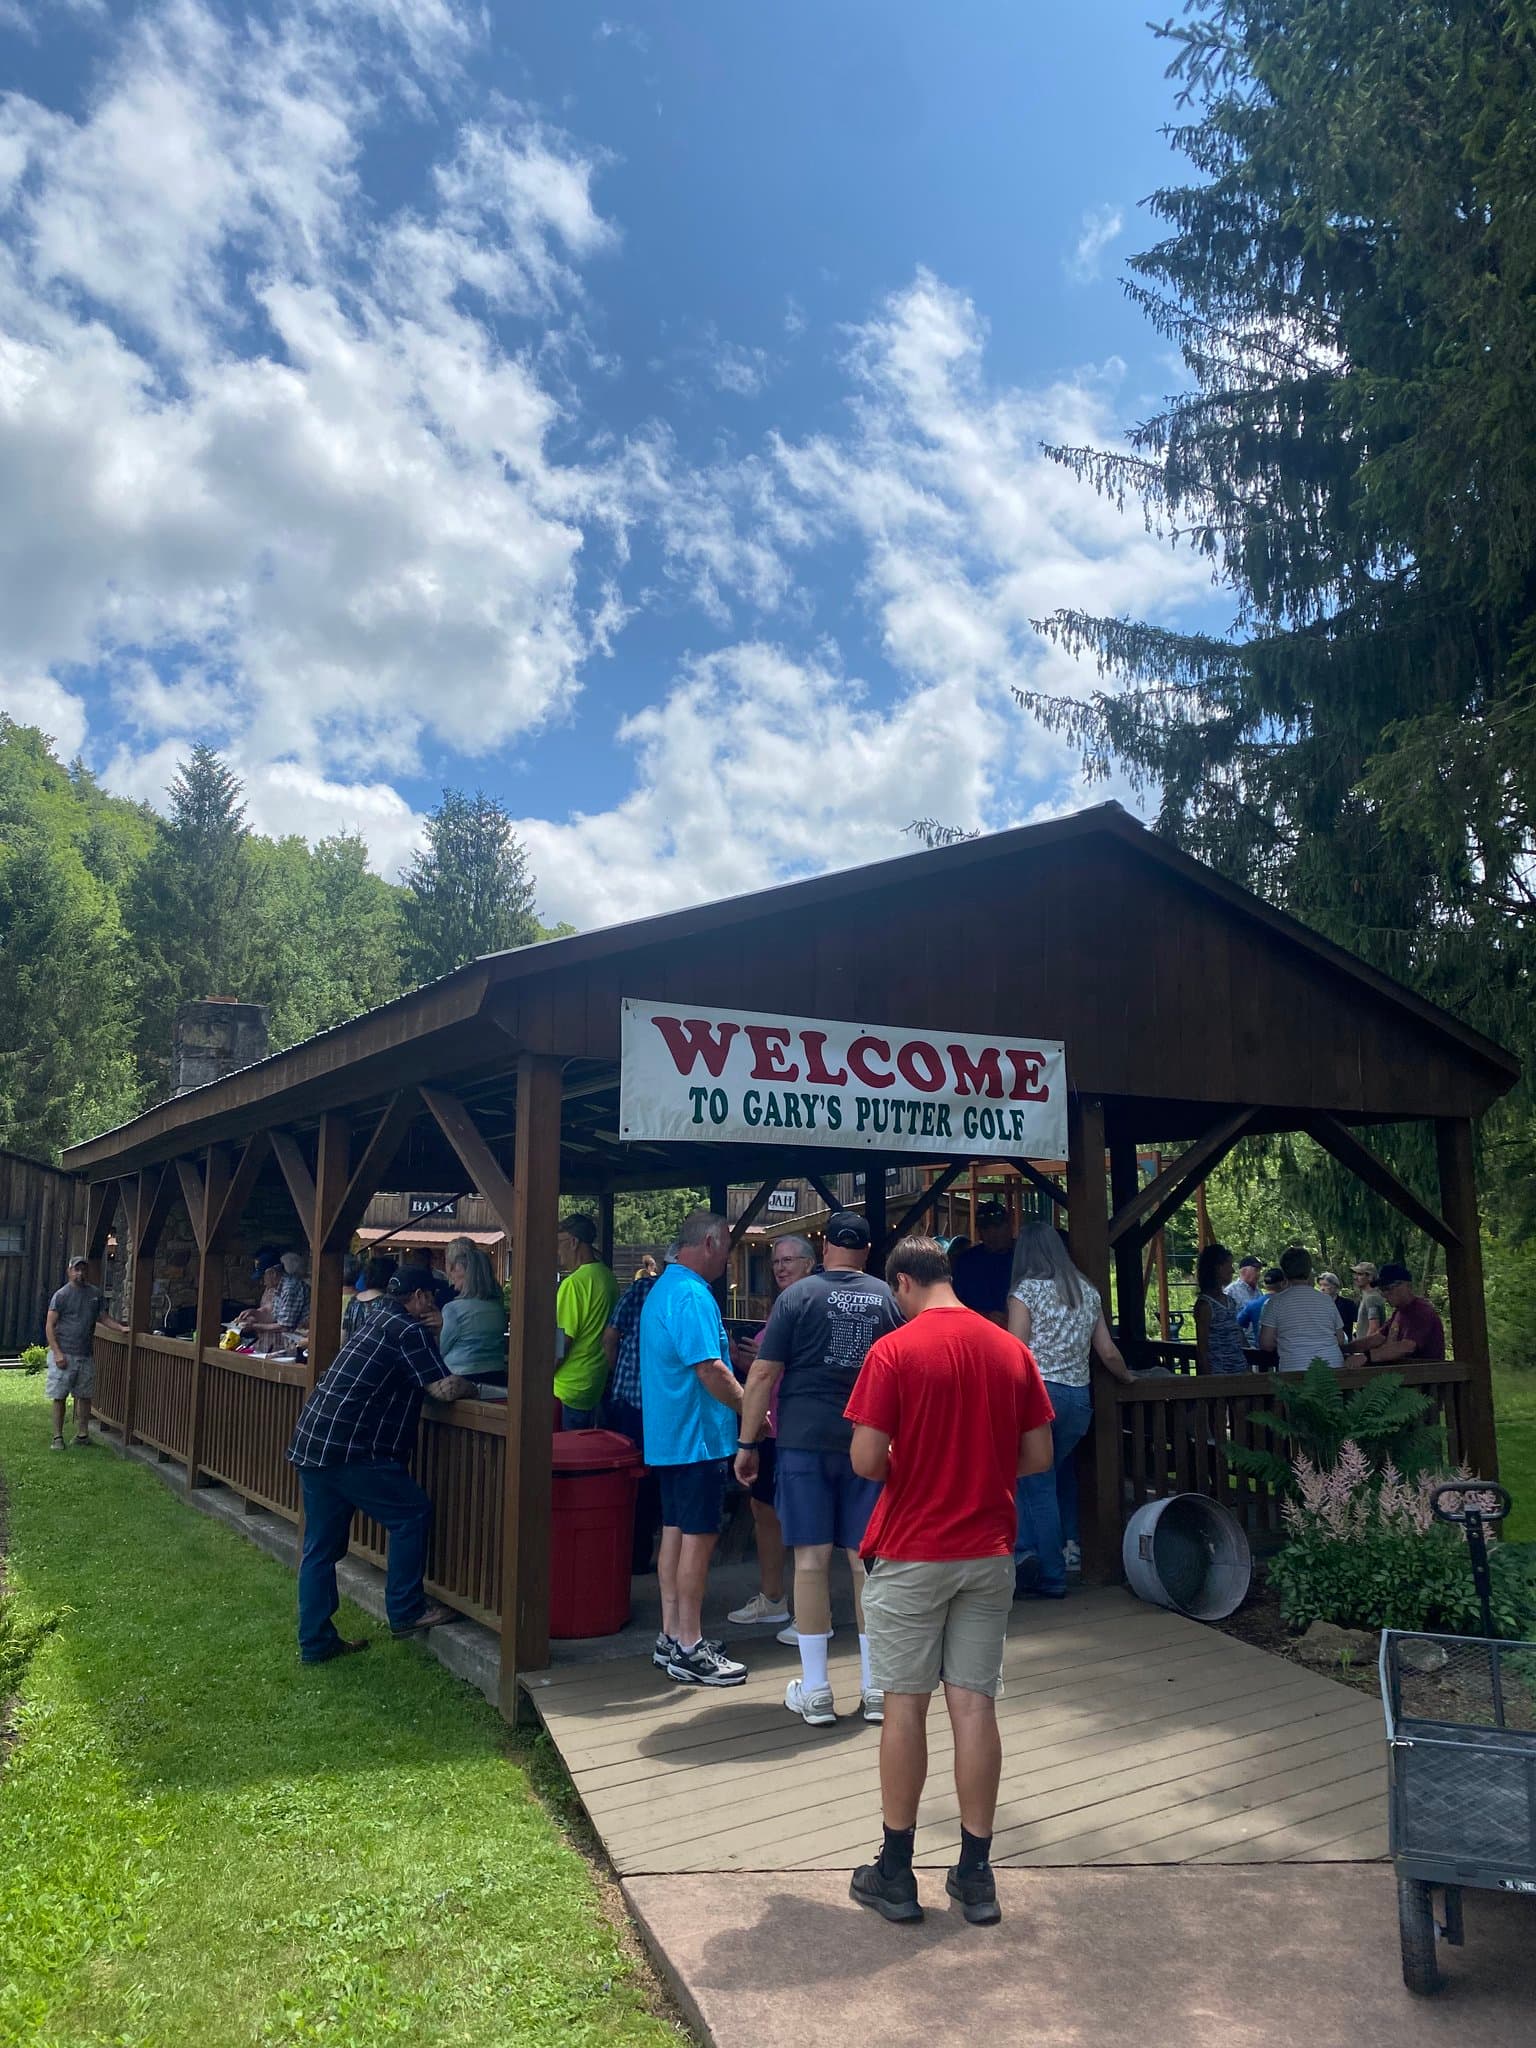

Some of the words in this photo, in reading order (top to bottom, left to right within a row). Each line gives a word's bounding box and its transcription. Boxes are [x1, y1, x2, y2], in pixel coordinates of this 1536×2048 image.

[651, 1016, 1050, 1103] WELCOME
[688, 1086, 729, 1125] TO
[742, 1089, 843, 1131] GARY'S
[855, 1096, 953, 1138] PUTTER
[963, 1105, 1026, 1141] GOLF
[768, 1194, 795, 1208] JAIL
[827, 1290, 883, 1306] SCOTTISH
[837, 1301, 868, 1315] RITE
